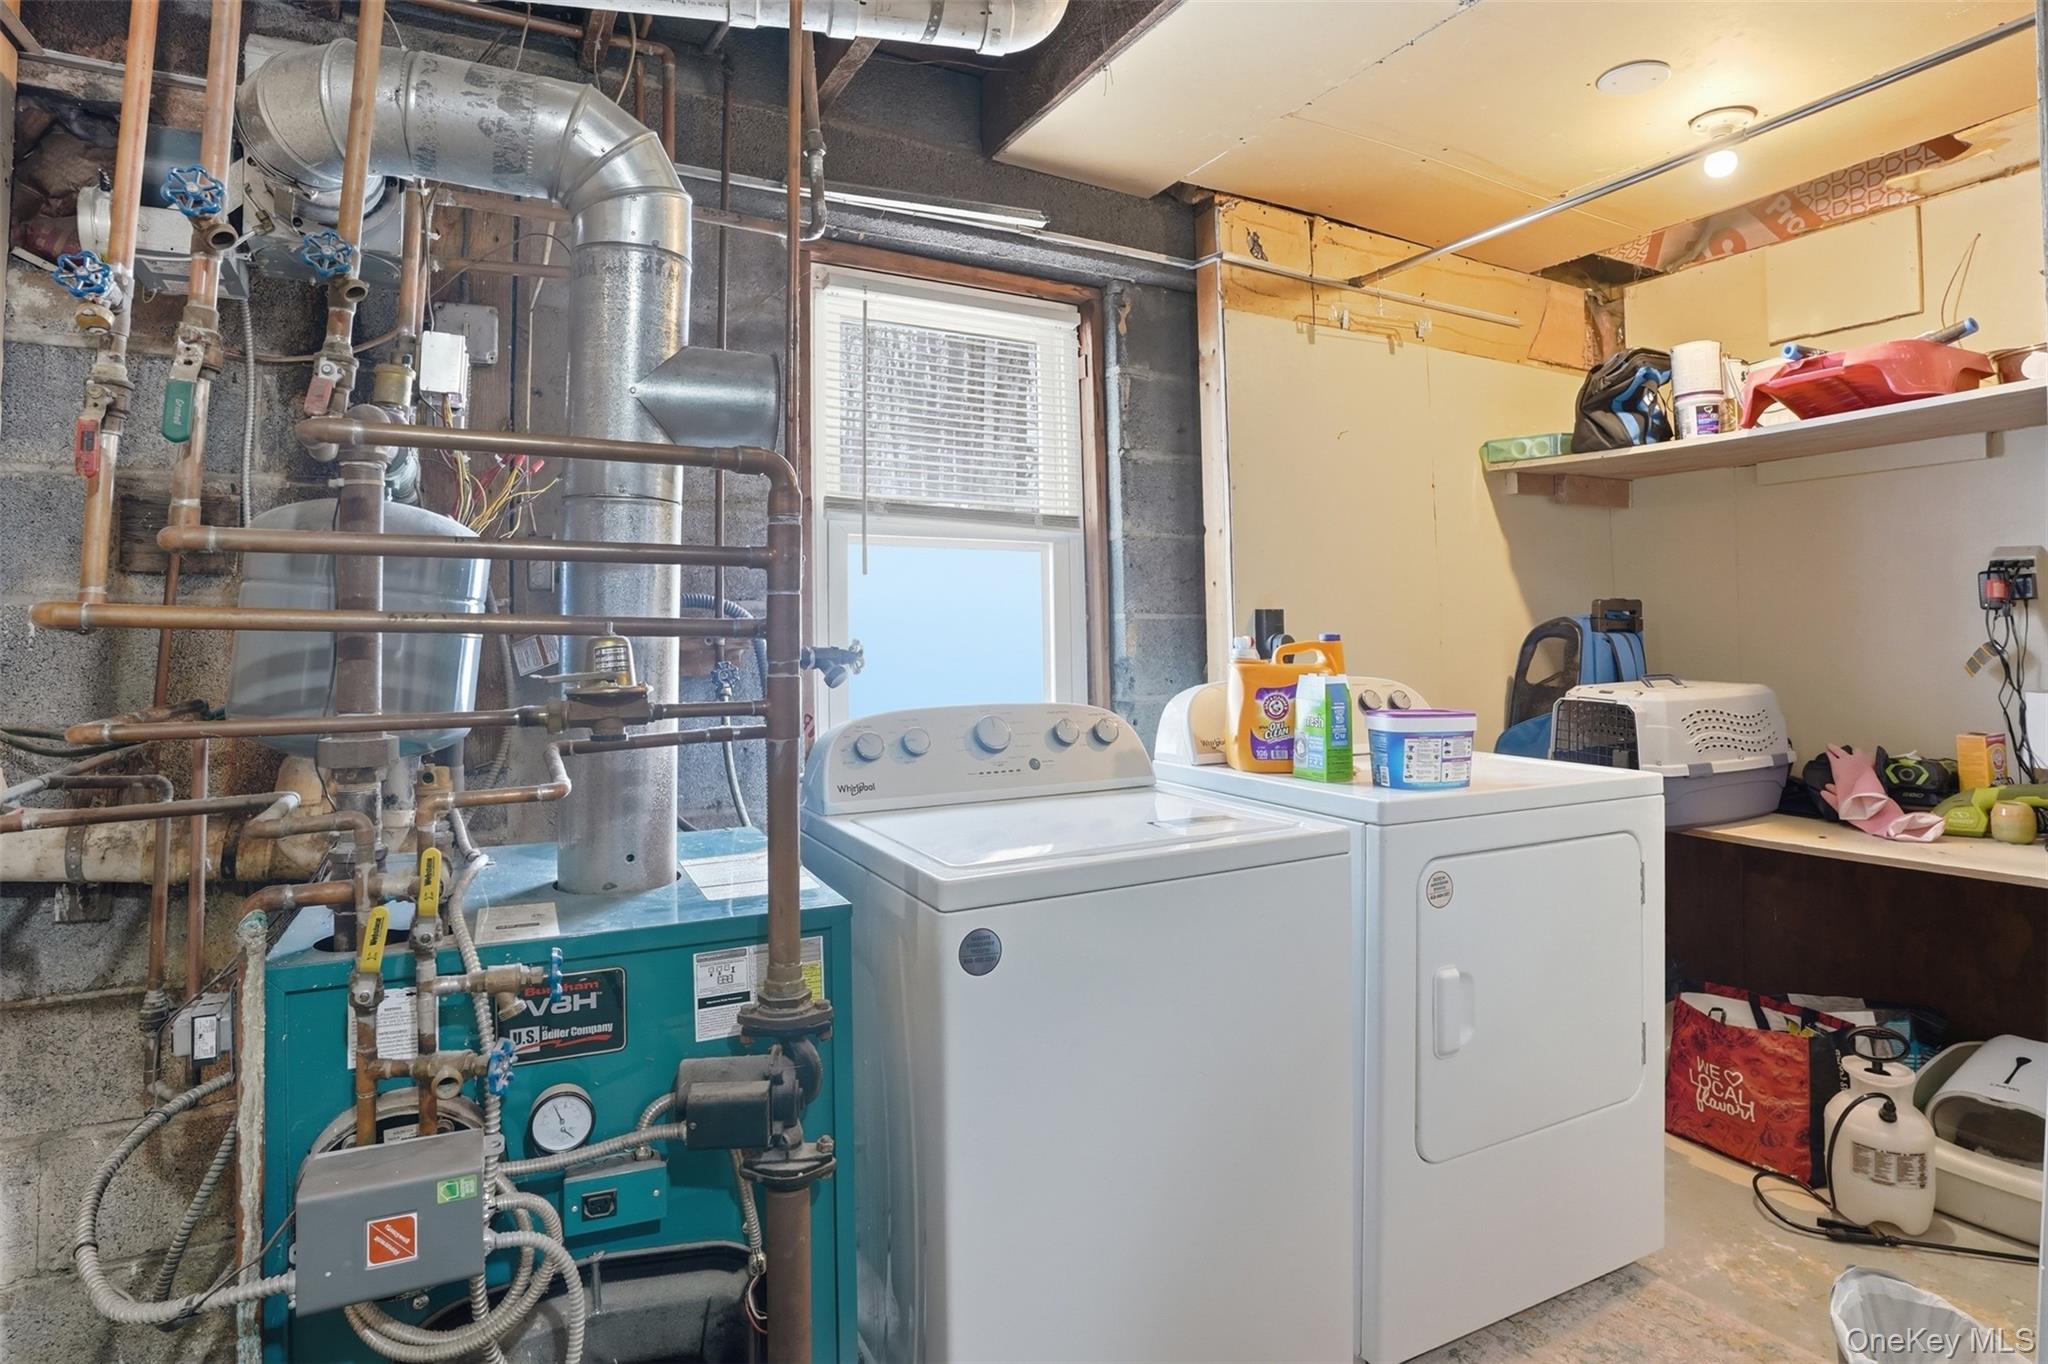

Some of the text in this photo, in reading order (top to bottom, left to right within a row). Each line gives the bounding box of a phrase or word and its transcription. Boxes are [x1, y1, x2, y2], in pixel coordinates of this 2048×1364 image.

[837, 782, 876, 797] Whirlpool
[524, 981, 600, 997] Burham
[512, 1029, 539, 1046] U.S.
[570, 1022, 614, 1036] Company
[1696, 1055, 1721, 1082] WE
[1688, 1068, 1752, 1108] LOCAL
